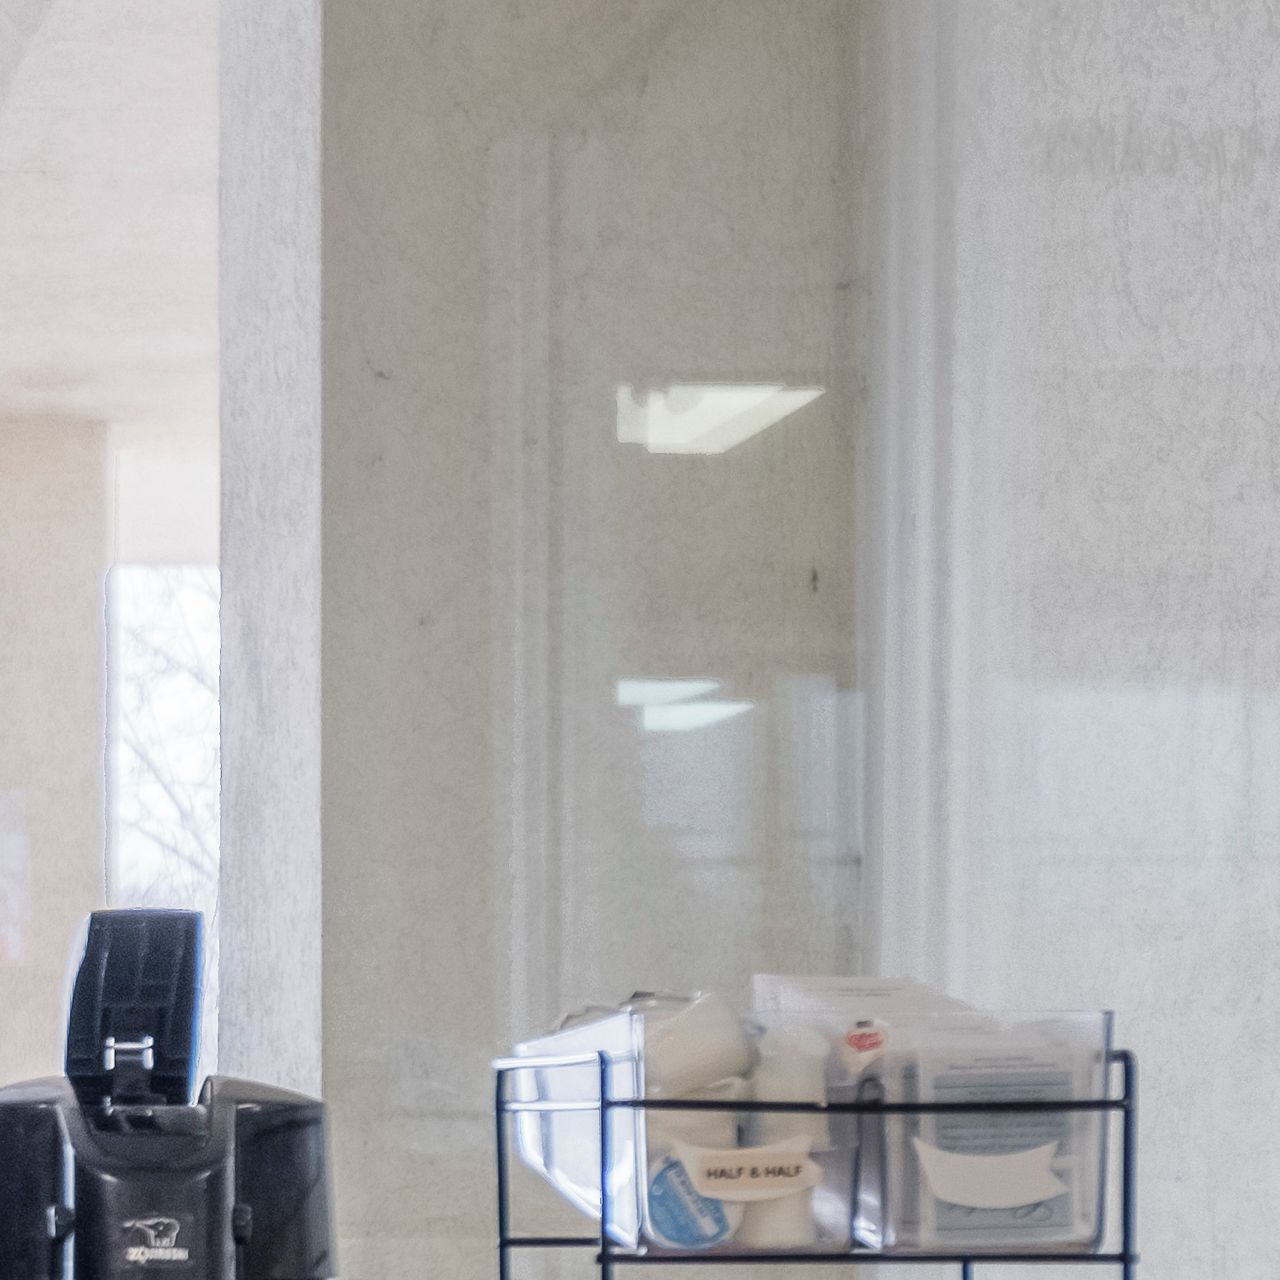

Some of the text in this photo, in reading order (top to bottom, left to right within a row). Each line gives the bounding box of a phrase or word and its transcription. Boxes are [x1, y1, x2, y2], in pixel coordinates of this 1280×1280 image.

[706, 1164, 804, 1180] HALF & HALF
